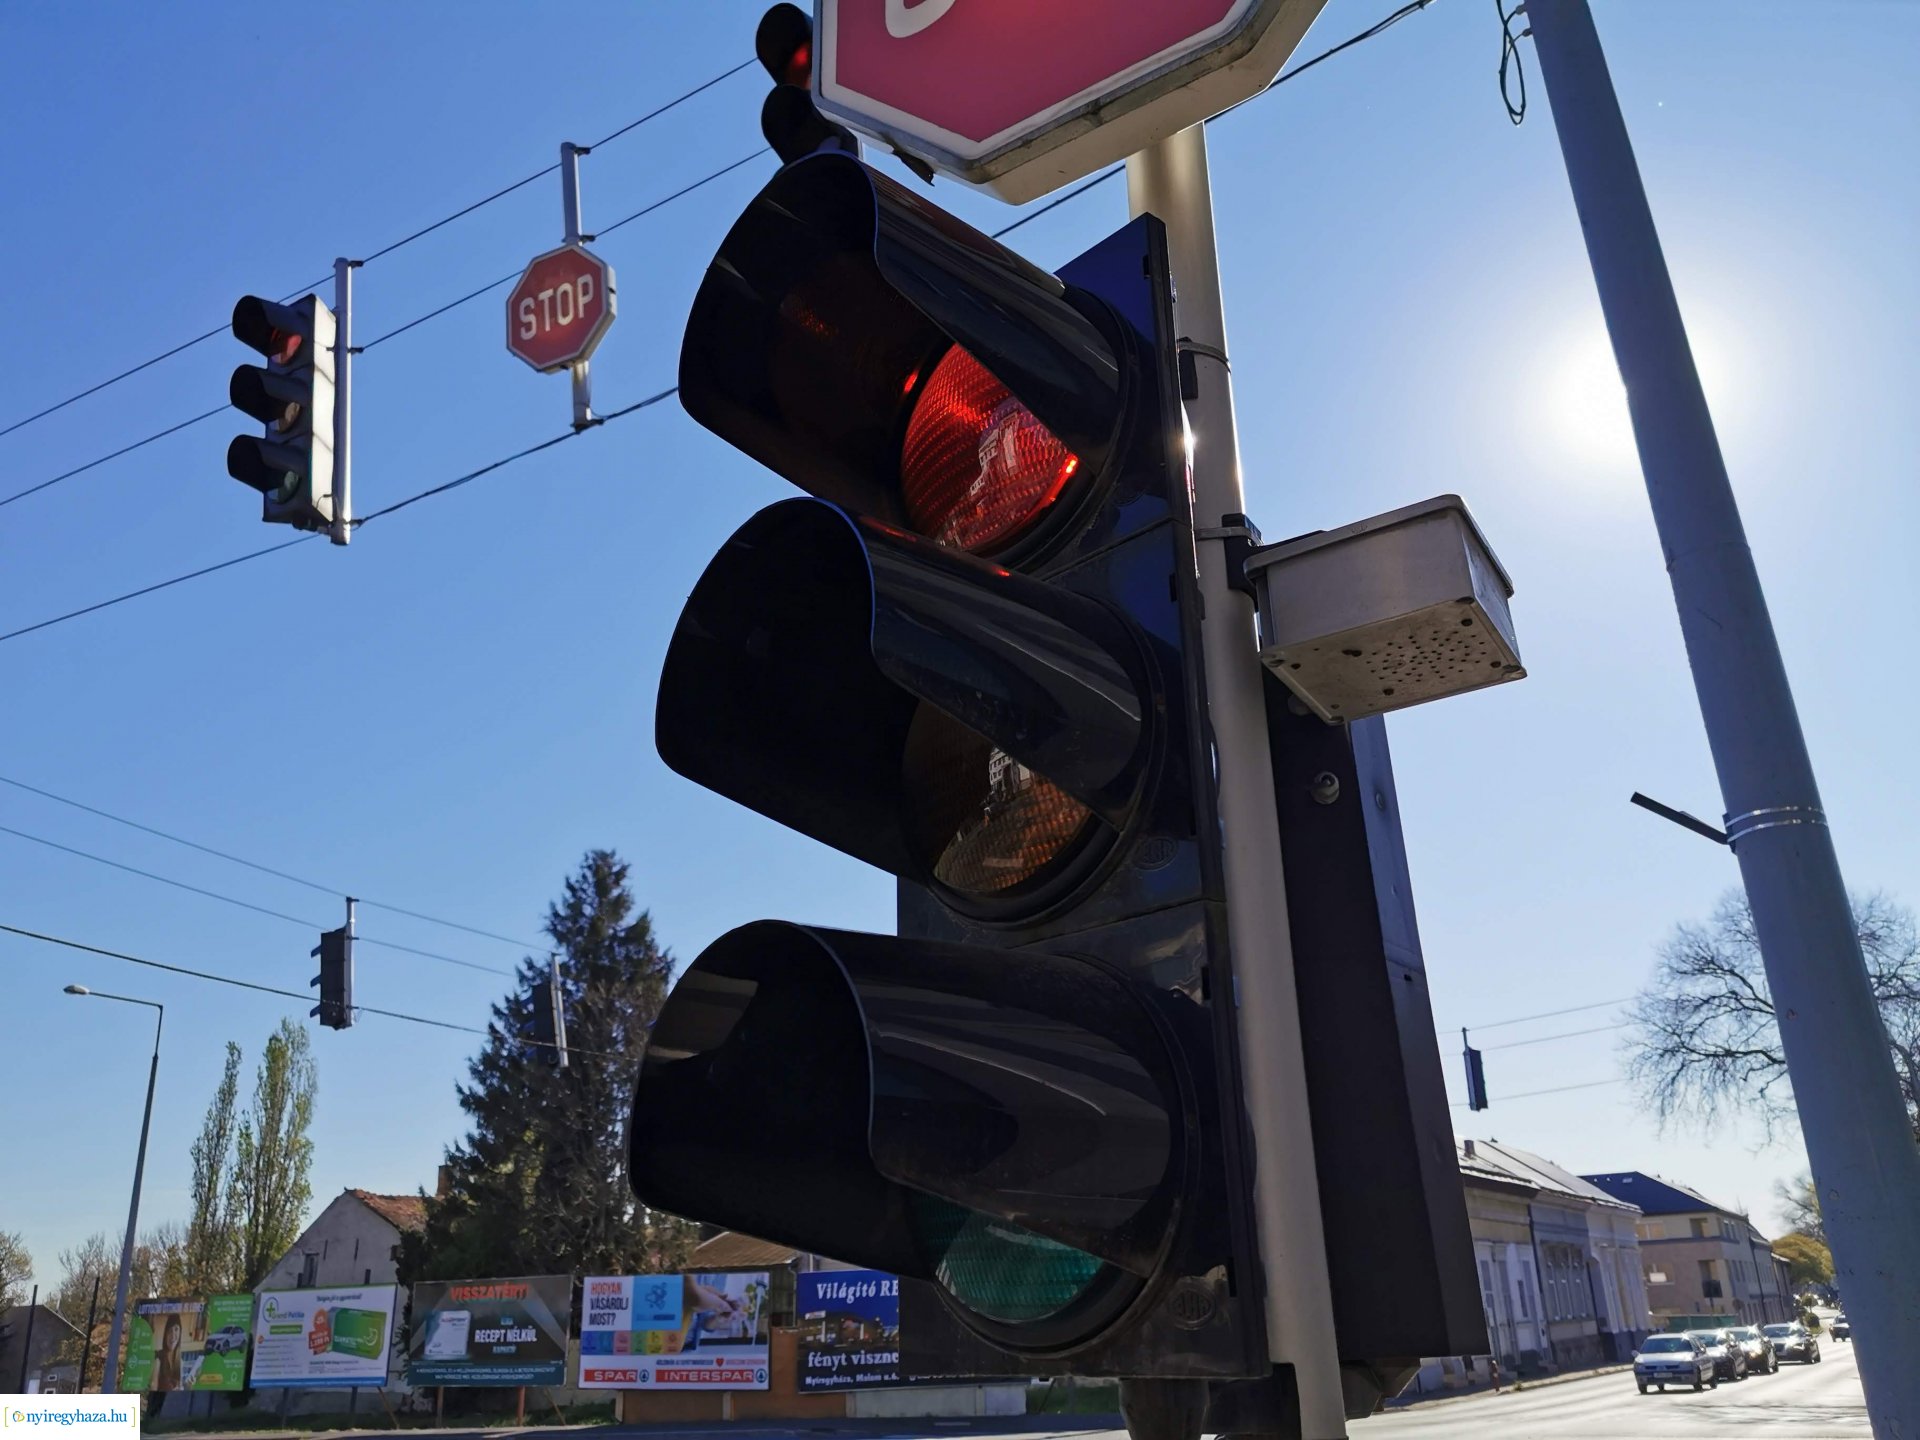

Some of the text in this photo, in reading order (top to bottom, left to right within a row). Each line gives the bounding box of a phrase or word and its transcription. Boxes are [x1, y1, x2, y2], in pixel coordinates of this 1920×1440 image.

[520, 274, 594, 340] STOP
[817, 1282, 876, 1304] Világító
[808, 1351, 848, 1371] fényt
[594, 1370, 637, 1381] SPAR
[665, 1369, 754, 1381] INTERSPAR
